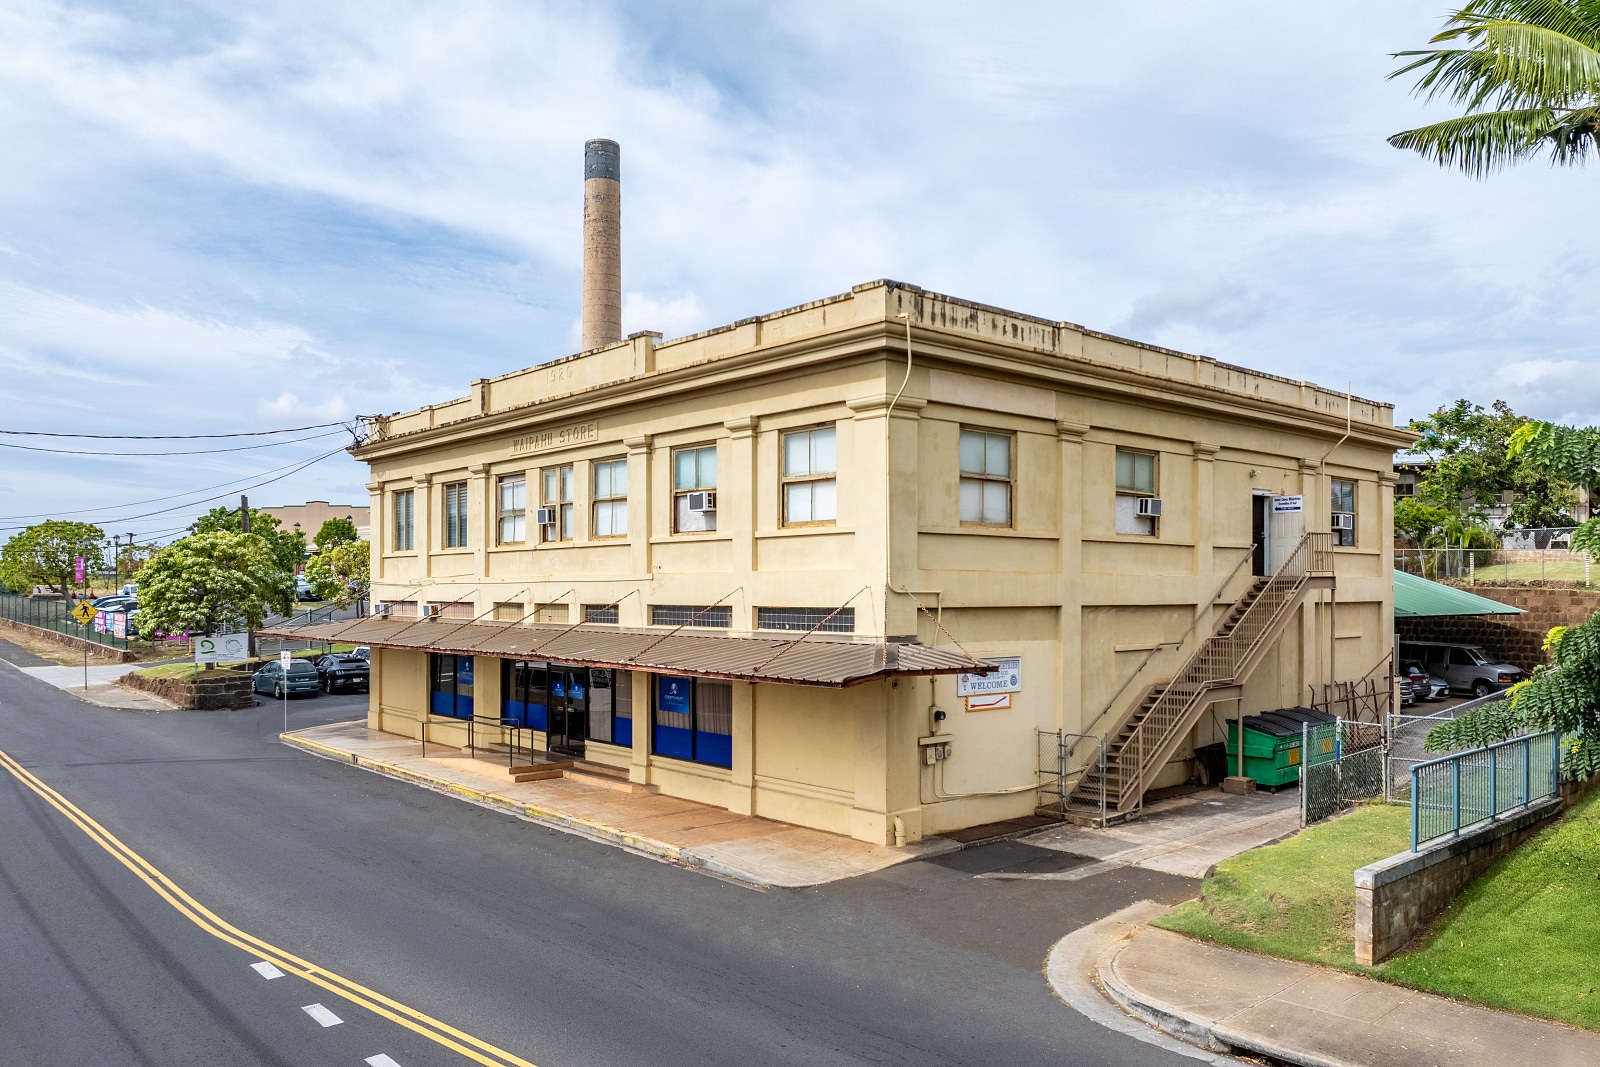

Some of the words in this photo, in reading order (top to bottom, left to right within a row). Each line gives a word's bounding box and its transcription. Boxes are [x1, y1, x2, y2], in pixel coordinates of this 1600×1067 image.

[546, 365, 573, 384] 1920
[512, 432, 553, 452] WAIPAHU
[559, 423, 594, 443] STORE
[970, 680, 1008, 690] WELCOME
